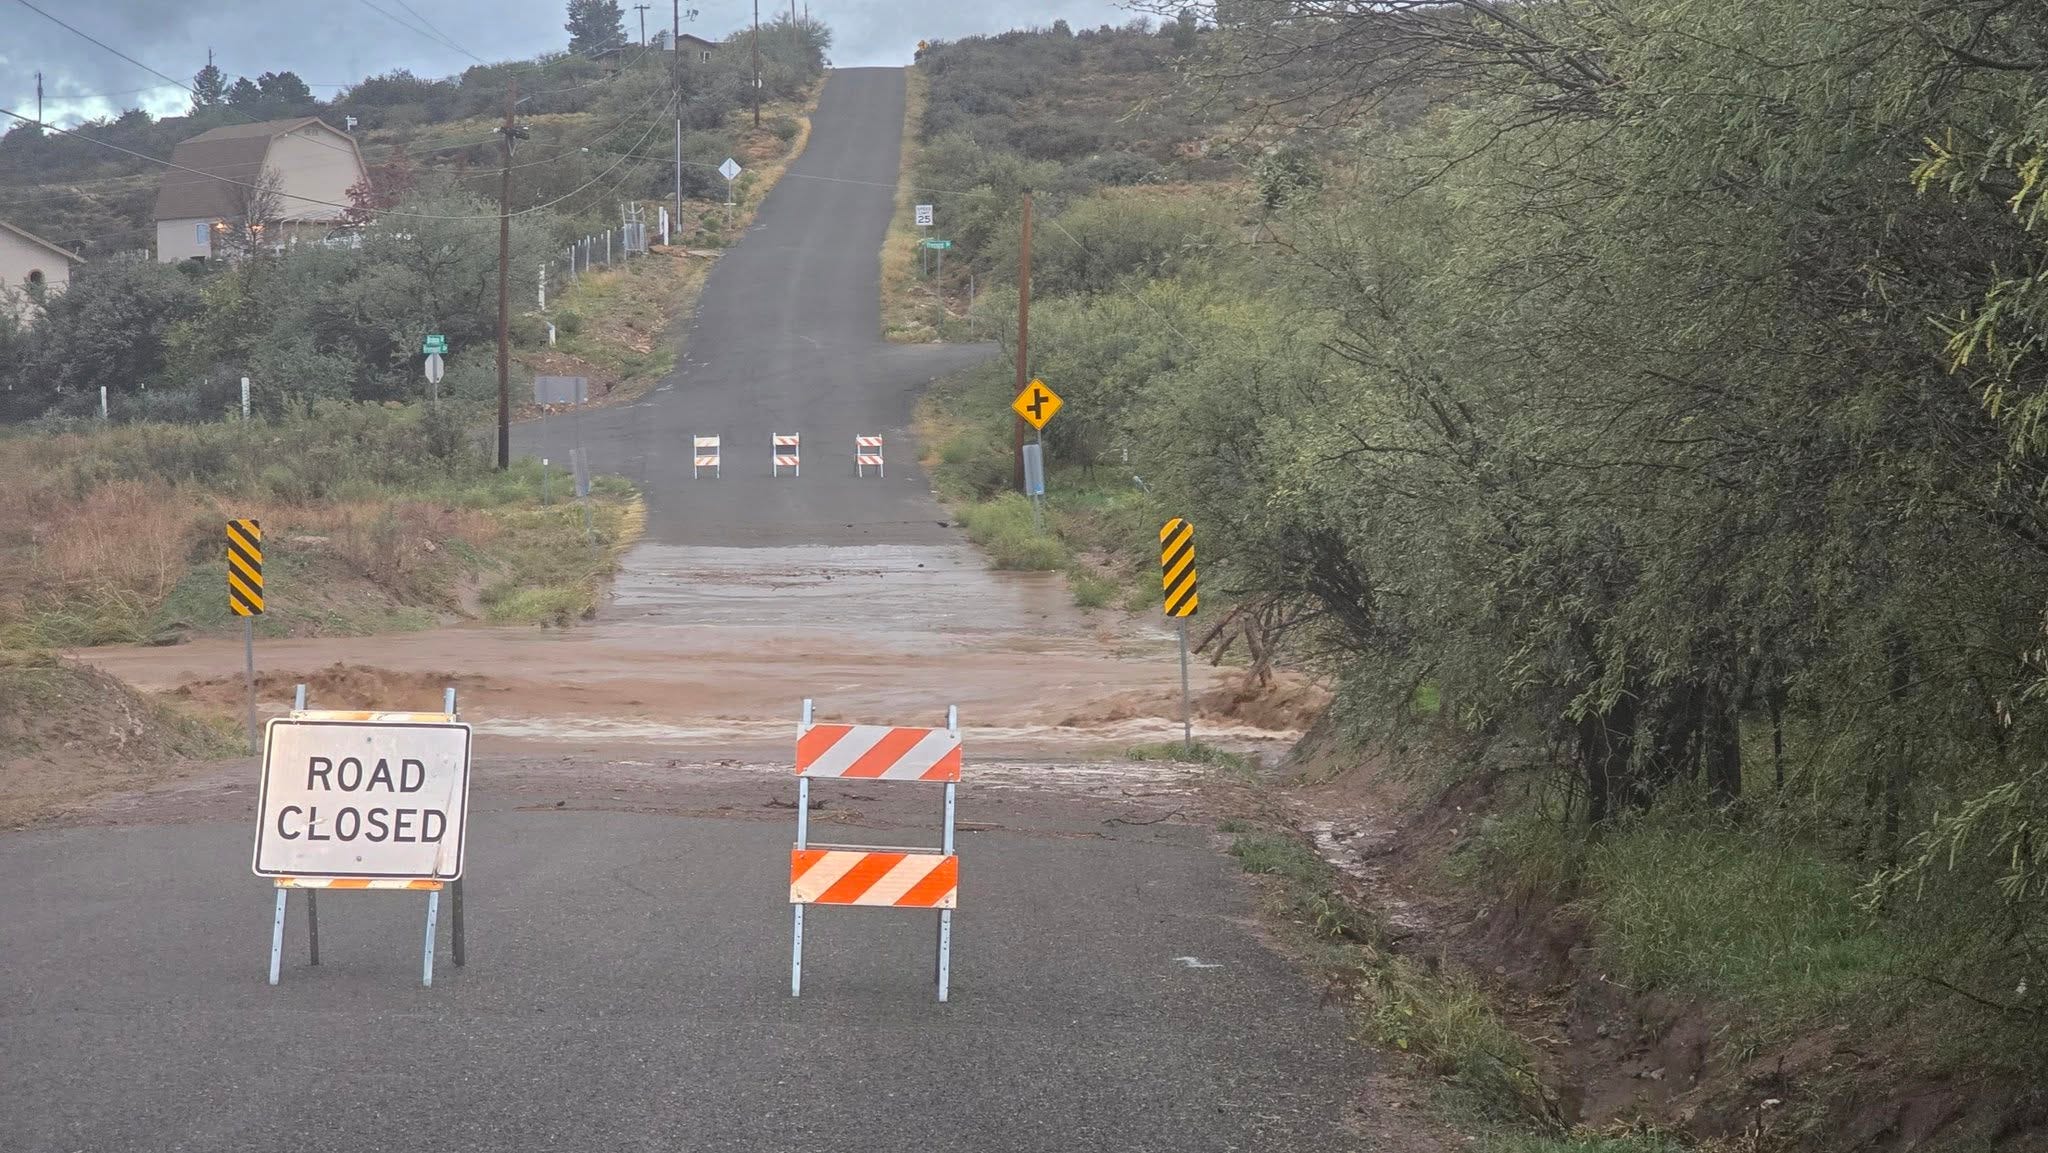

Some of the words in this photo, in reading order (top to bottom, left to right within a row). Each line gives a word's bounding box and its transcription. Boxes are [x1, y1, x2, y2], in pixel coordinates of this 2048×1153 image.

[918, 215, 931, 224] 25
[307, 756, 426, 793] ROAD
[277, 805, 447, 843] CLOSED
